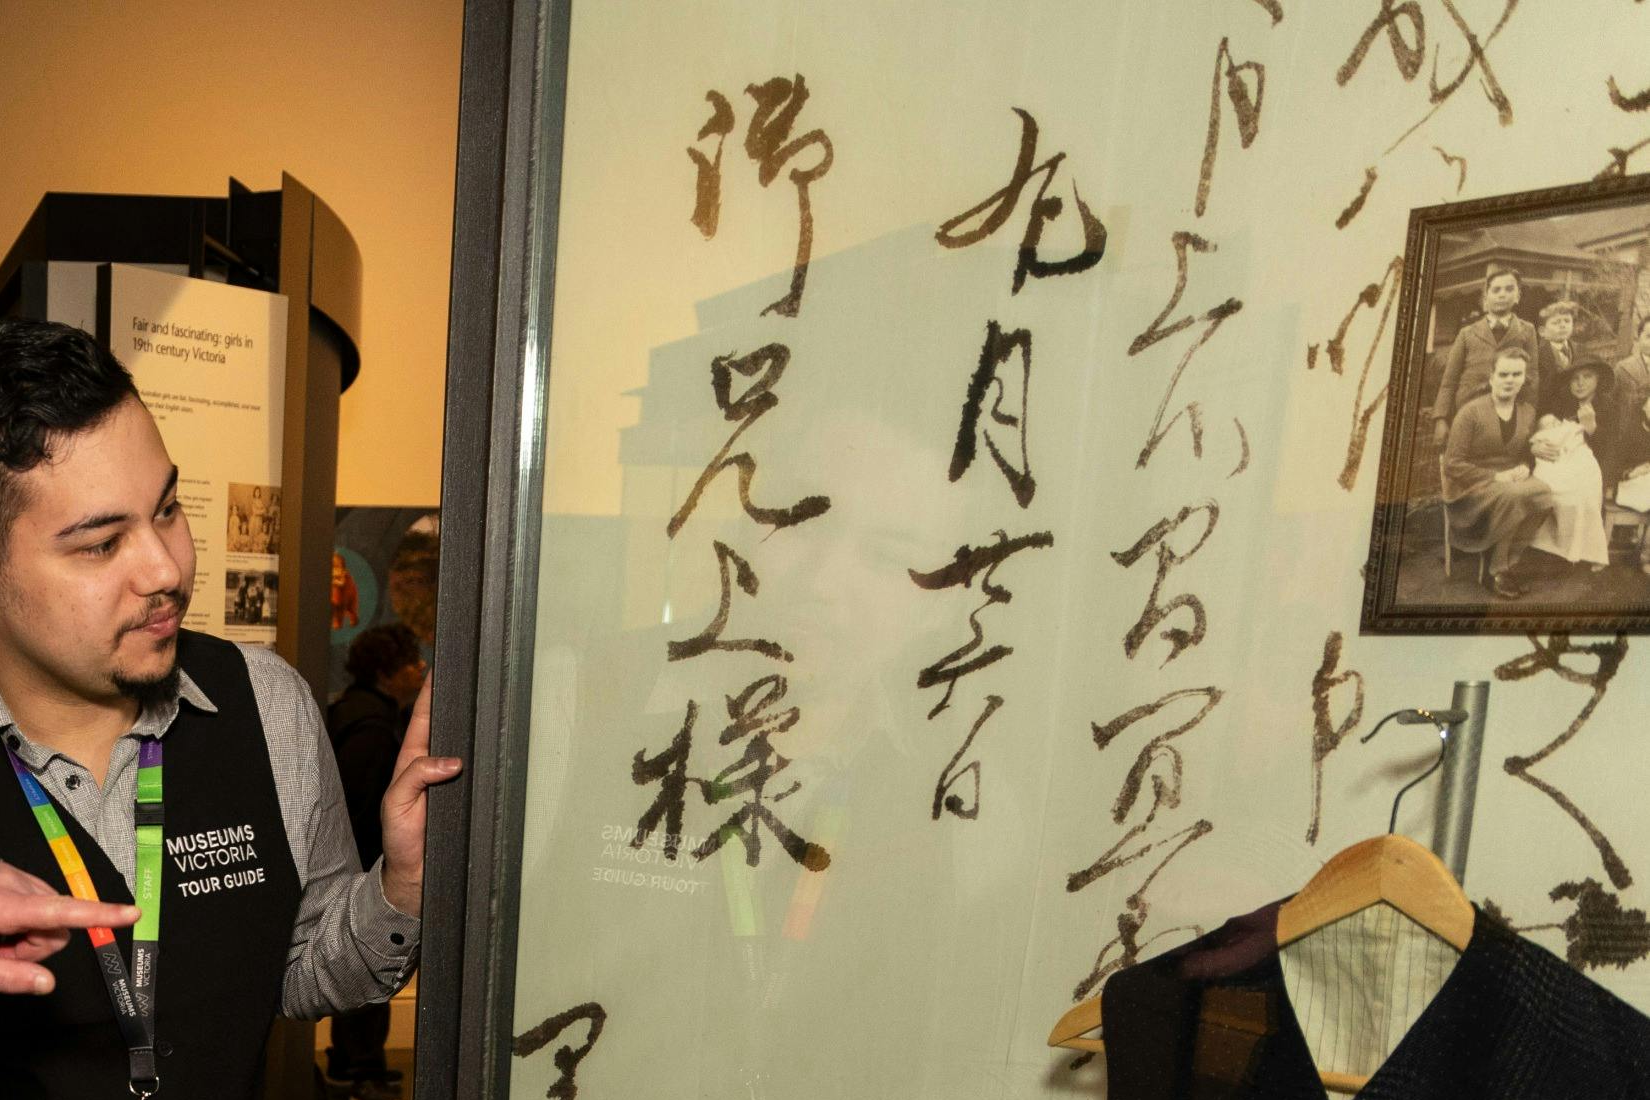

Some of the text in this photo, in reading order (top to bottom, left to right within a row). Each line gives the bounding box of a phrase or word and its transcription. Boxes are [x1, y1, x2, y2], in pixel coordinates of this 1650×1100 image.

[132, 316, 253, 349] Fair and fascinating: girls in
[133, 337, 226, 364] 19th century Victoria
[166, 824, 255, 855] MUSEUMS
[174, 844, 257, 873] VICTORIA
[142, 868, 153, 900] STAFF
[178, 868, 266, 897] TOUR GUIDE
[136, 948, 144, 987] MUSEUMS
[143, 953, 151, 987] VICTORIA
[112, 981, 127, 1015] VICTORIA
[118, 979, 137, 1017] MUSEUMS
